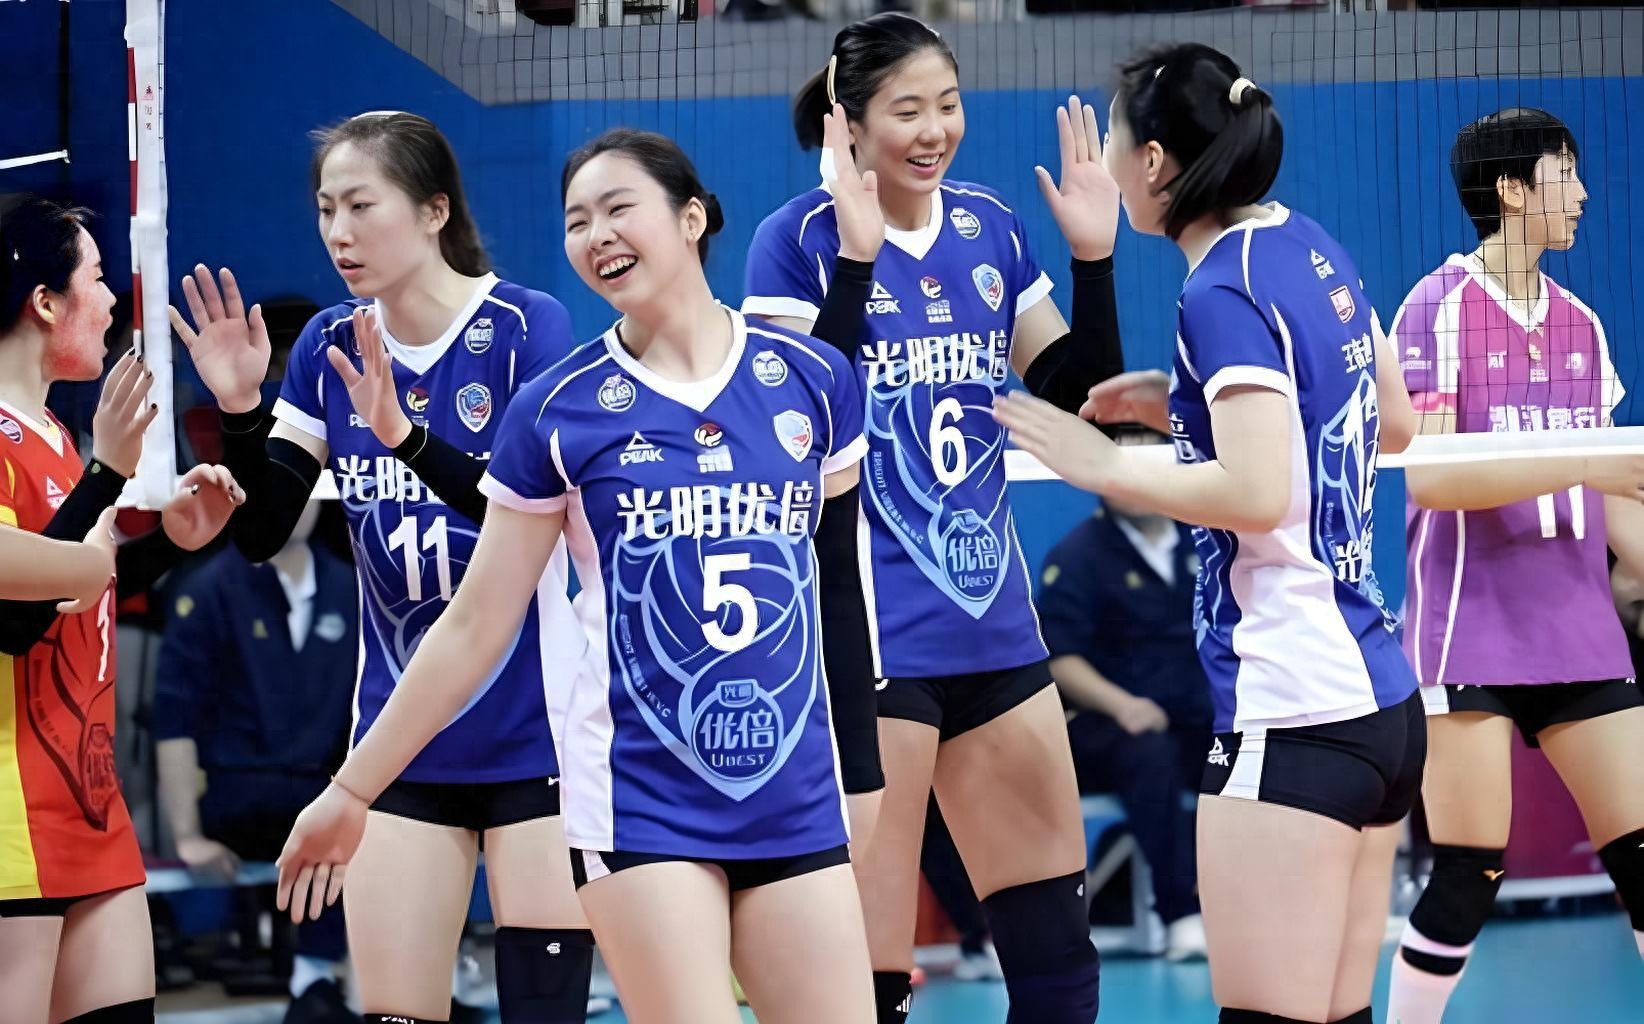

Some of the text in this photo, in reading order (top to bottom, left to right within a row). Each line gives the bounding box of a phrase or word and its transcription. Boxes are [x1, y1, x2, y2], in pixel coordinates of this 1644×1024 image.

[929, 398, 967, 487] 6
[616, 480, 814, 542] 光明优倍
[388, 515, 451, 601] 11
[701, 552, 759, 651] 5
[700, 709, 775, 750] 优倍
